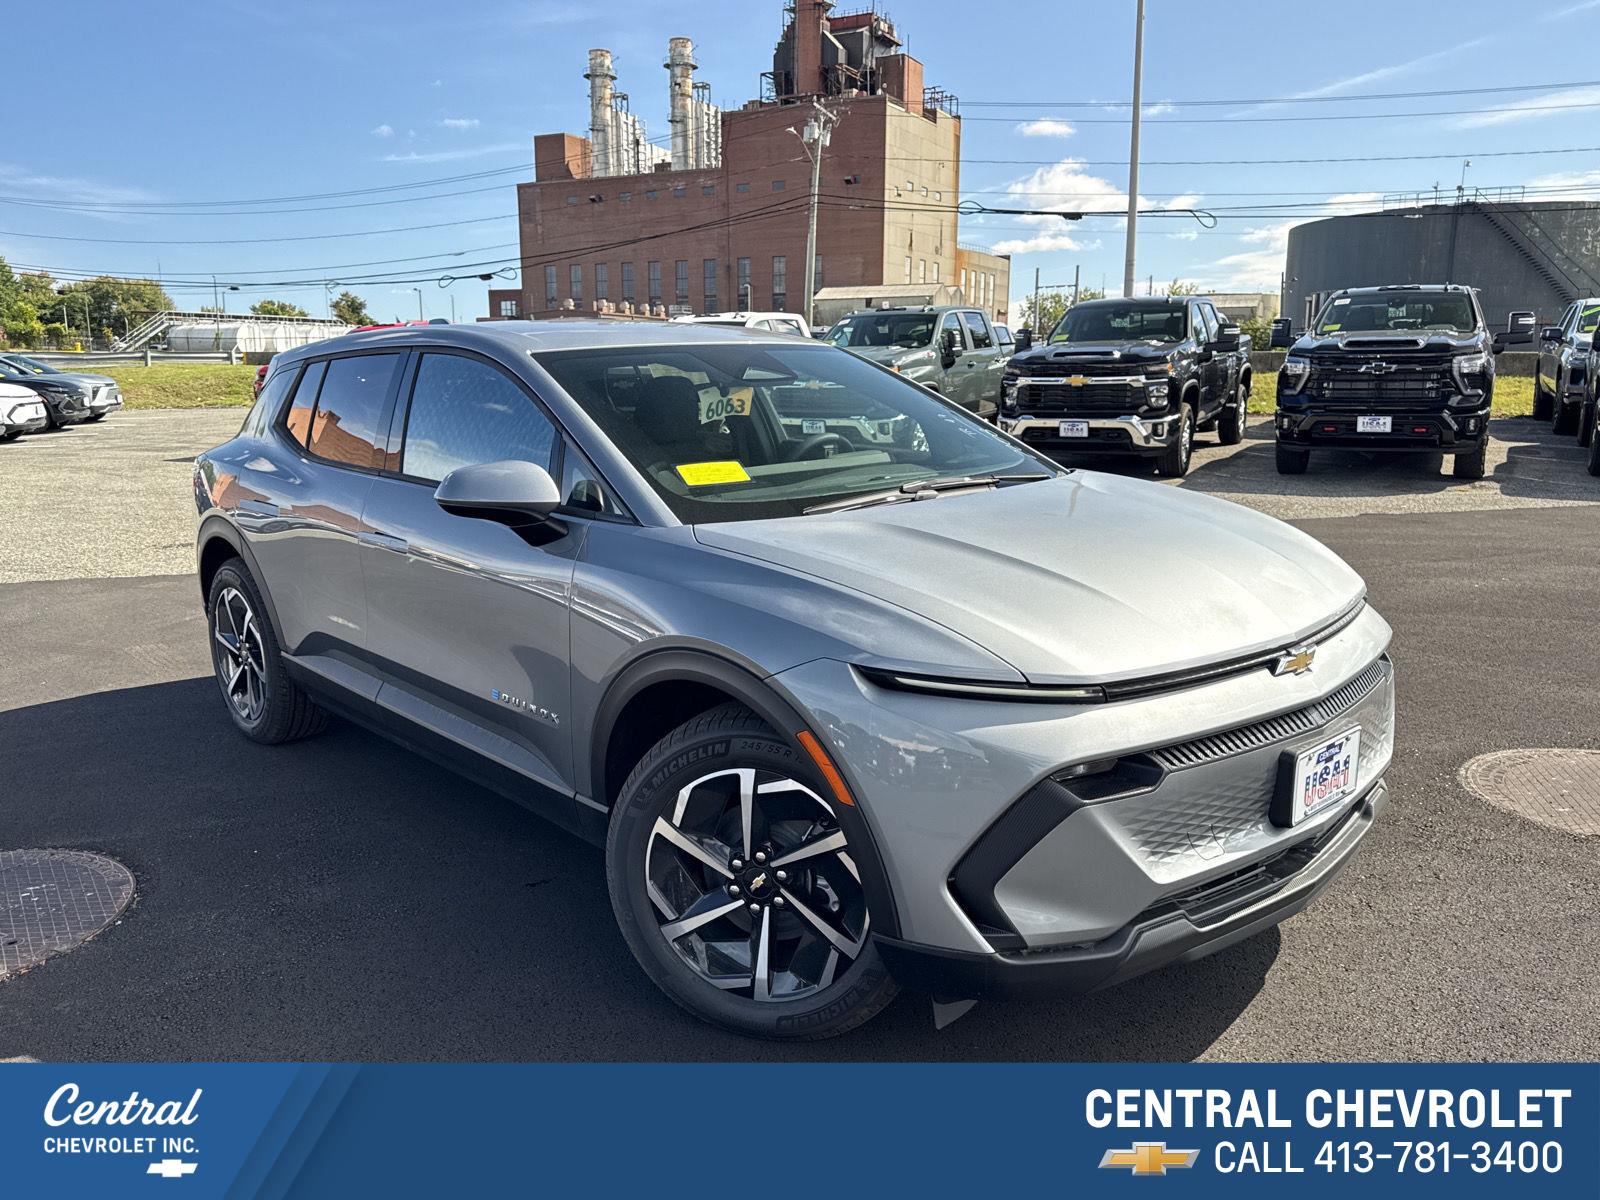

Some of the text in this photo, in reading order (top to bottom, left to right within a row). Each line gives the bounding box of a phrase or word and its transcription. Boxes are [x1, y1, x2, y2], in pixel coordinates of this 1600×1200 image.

[705, 397, 746, 420] 6063
[491, 688, 560, 725] EQUINOX
[741, 741, 783, 754] 245/55
[652, 741, 728, 789] MICHELIN
